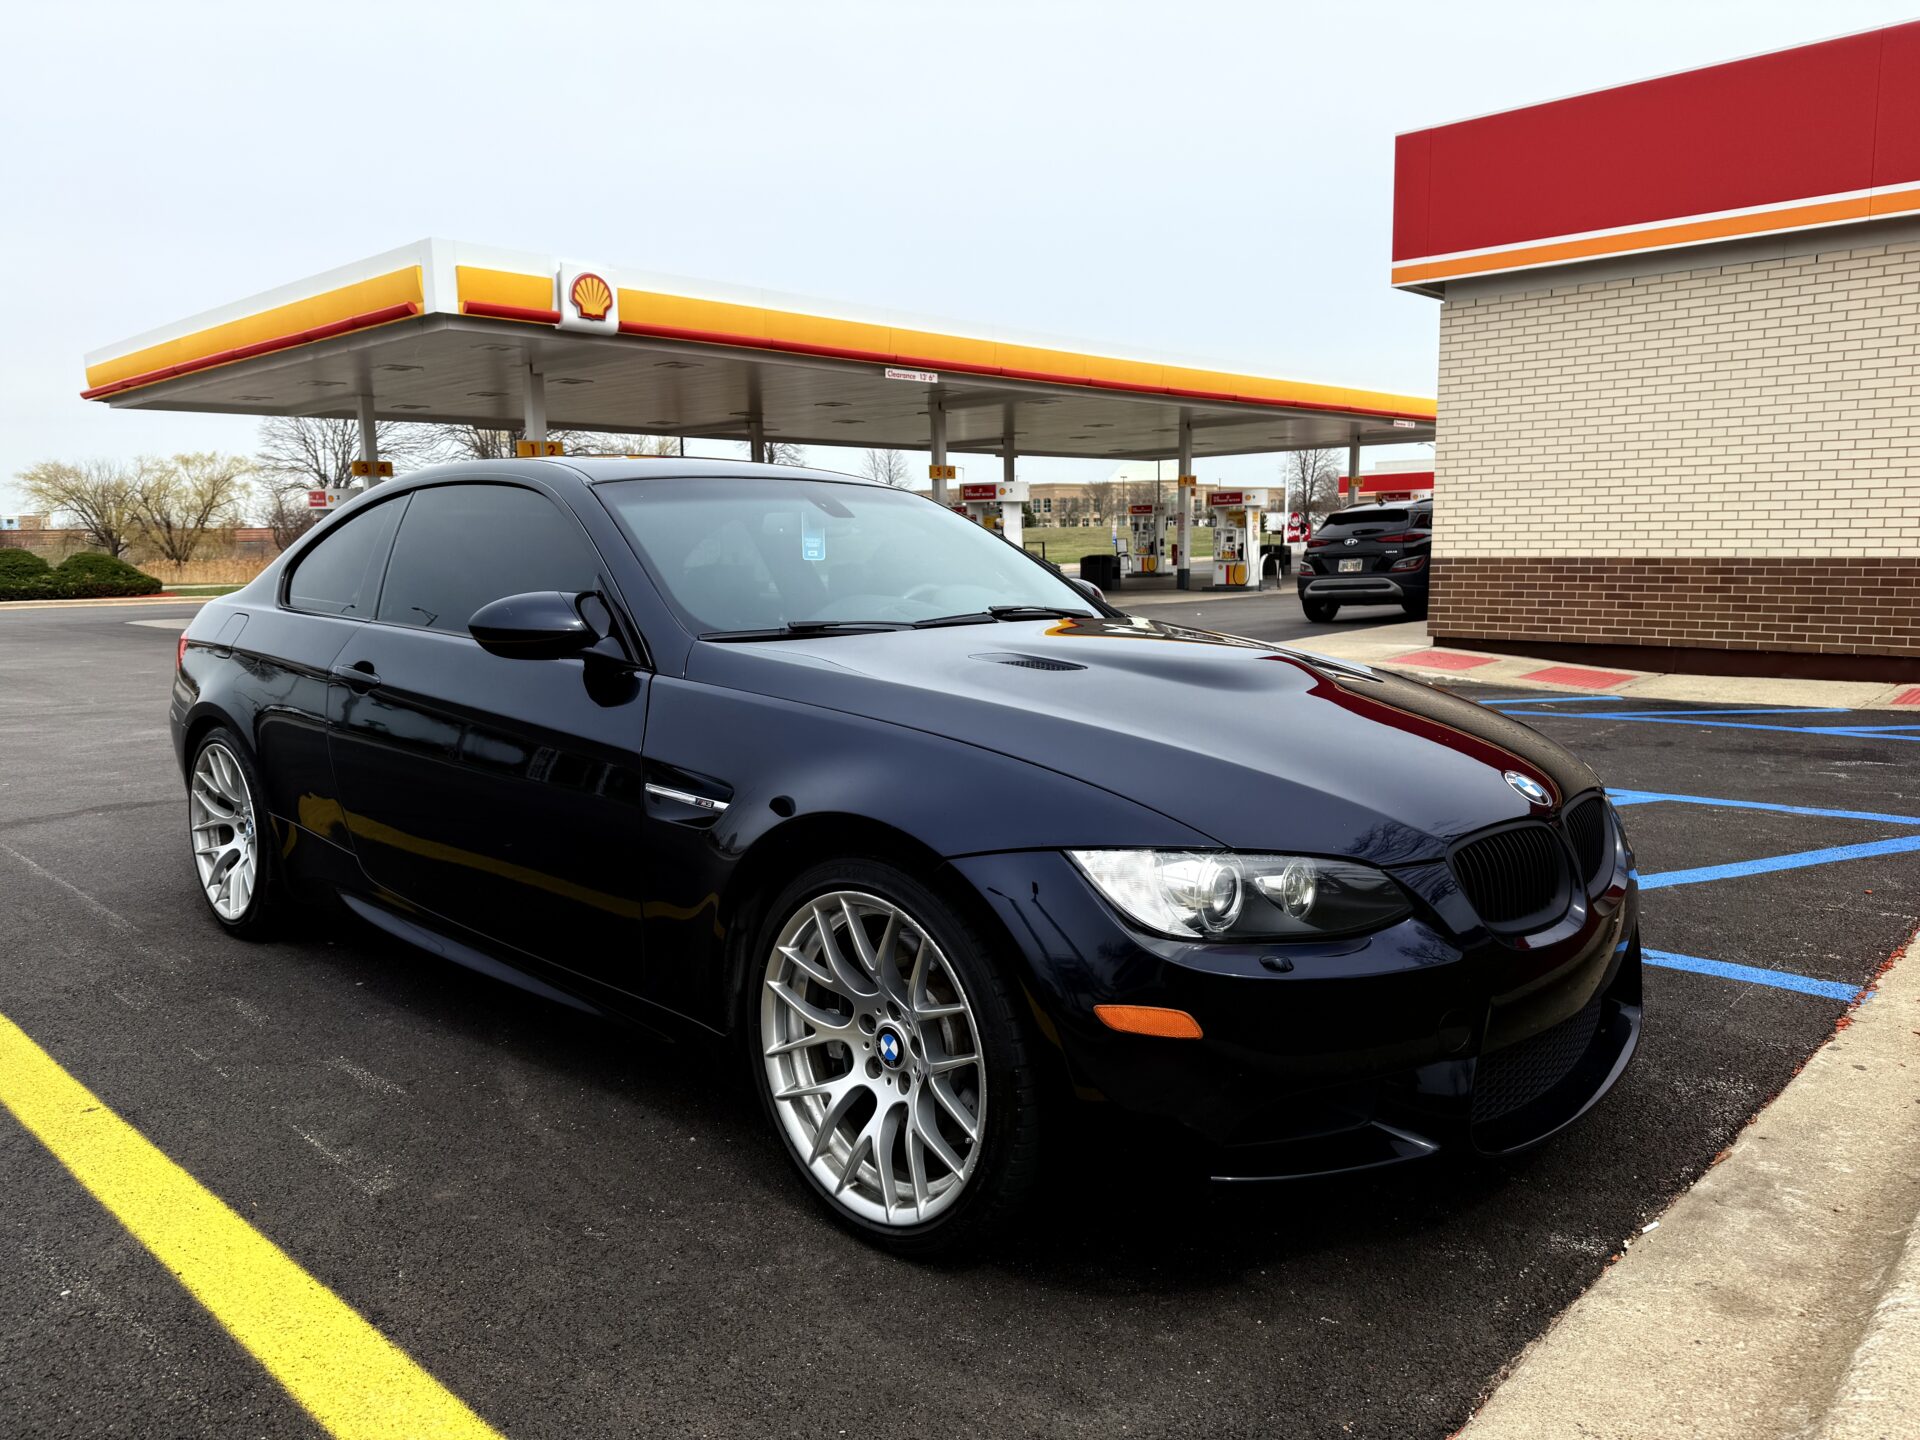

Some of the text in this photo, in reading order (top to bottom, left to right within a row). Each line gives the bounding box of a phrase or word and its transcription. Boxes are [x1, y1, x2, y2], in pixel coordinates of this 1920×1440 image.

[887, 370, 917, 380] Clearance
[548, 444, 556, 456] 2
[361, 463, 386, 474] 3 4
[946, 469, 952, 477] 6
